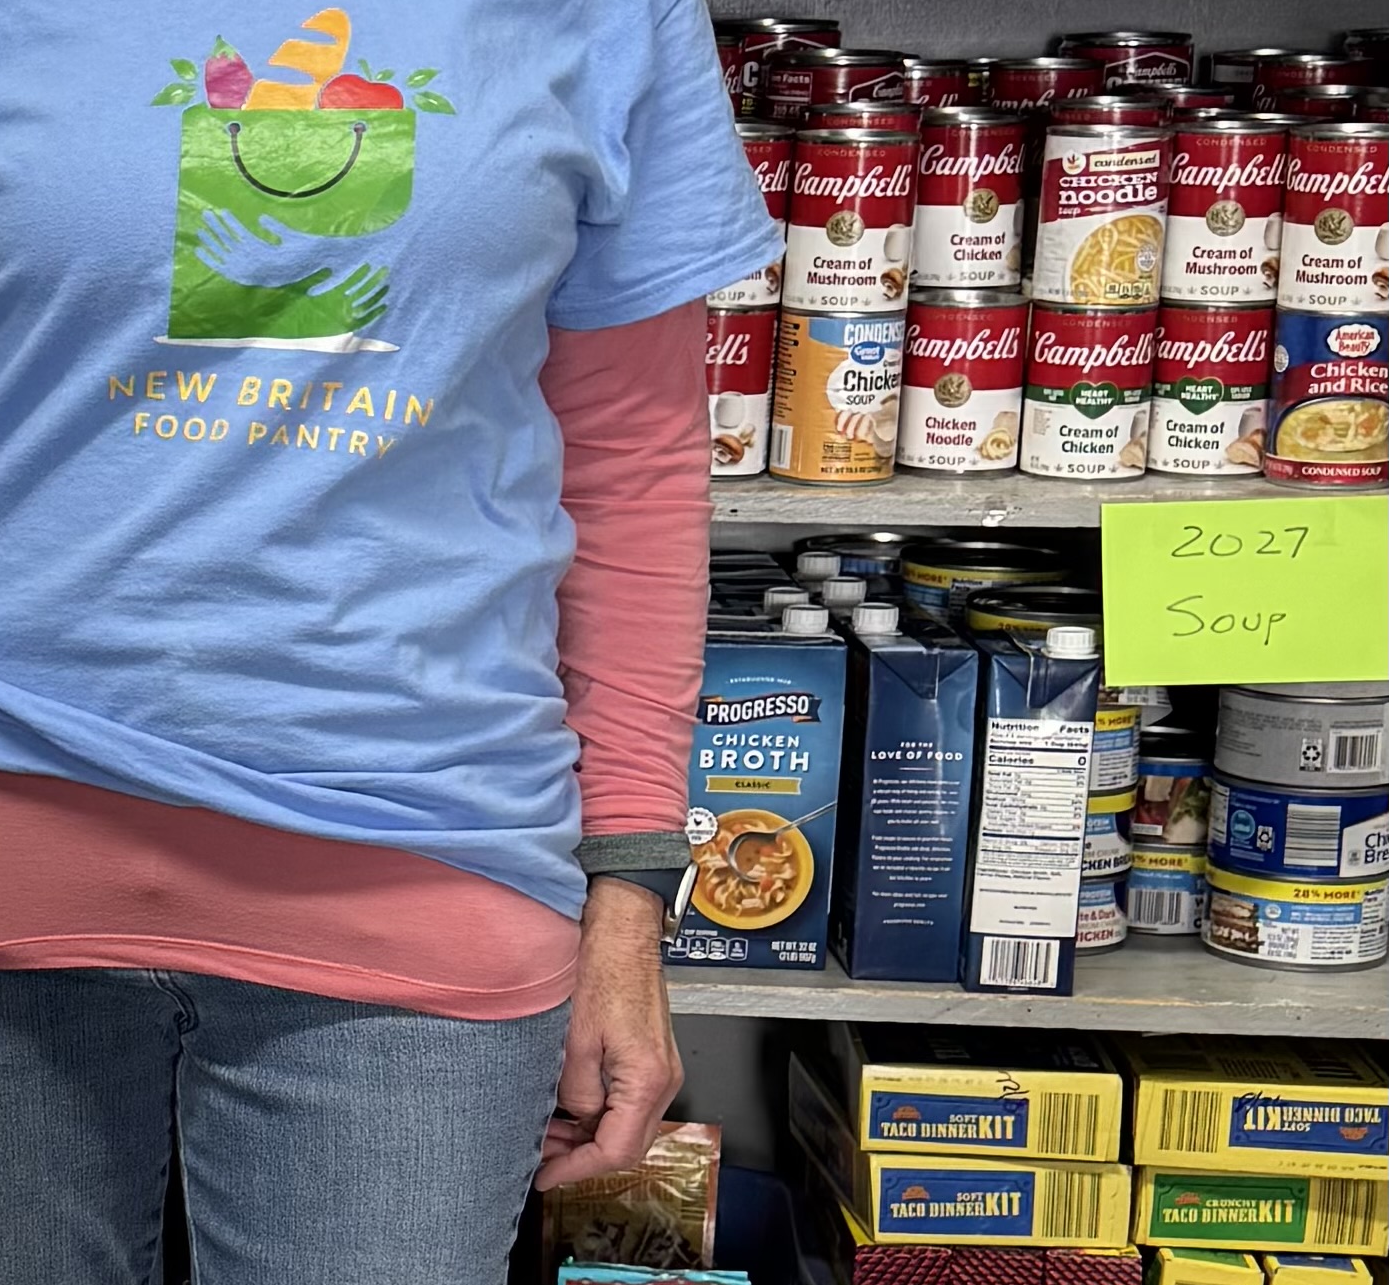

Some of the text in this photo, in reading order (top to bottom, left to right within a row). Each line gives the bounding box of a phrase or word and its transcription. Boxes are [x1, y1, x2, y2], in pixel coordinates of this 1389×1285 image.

[794, 162, 911, 201] Campbell's
[1059, 184, 1158, 206] noodle
[813, 257, 872, 271] Cream of
[1191, 247, 1252, 261] Cream of
[806, 271, 877, 287] Mushroom
[1185, 262, 1258, 277] Mushroom
[1310, 363, 1389, 379] Chicken
[1308, 378, 1388, 395] and Rice
[109, 370, 435, 428] NEW BRITAIN
[134, 412, 397, 459] FOOD PANTRY
[925, 432, 973, 447] Noodle
[1170, 525, 1310, 559] 2027
[1165, 594, 1287, 646] Soup
[706, 695, 811, 723] PROGRESSO
[711, 733, 801, 749] CHICKEN
[698, 749, 810, 771] BROTH
[870, 751, 963, 762] LOVE OF FOOD
[880, 1113, 1015, 1140] TACO DINNER KIT
[890, 1191, 1021, 1218] TACO DINNER KIT
[1163, 1199, 1296, 1224] TACO DINNER KIT
[1205, 1198, 1257, 1208] CRUNCHY
